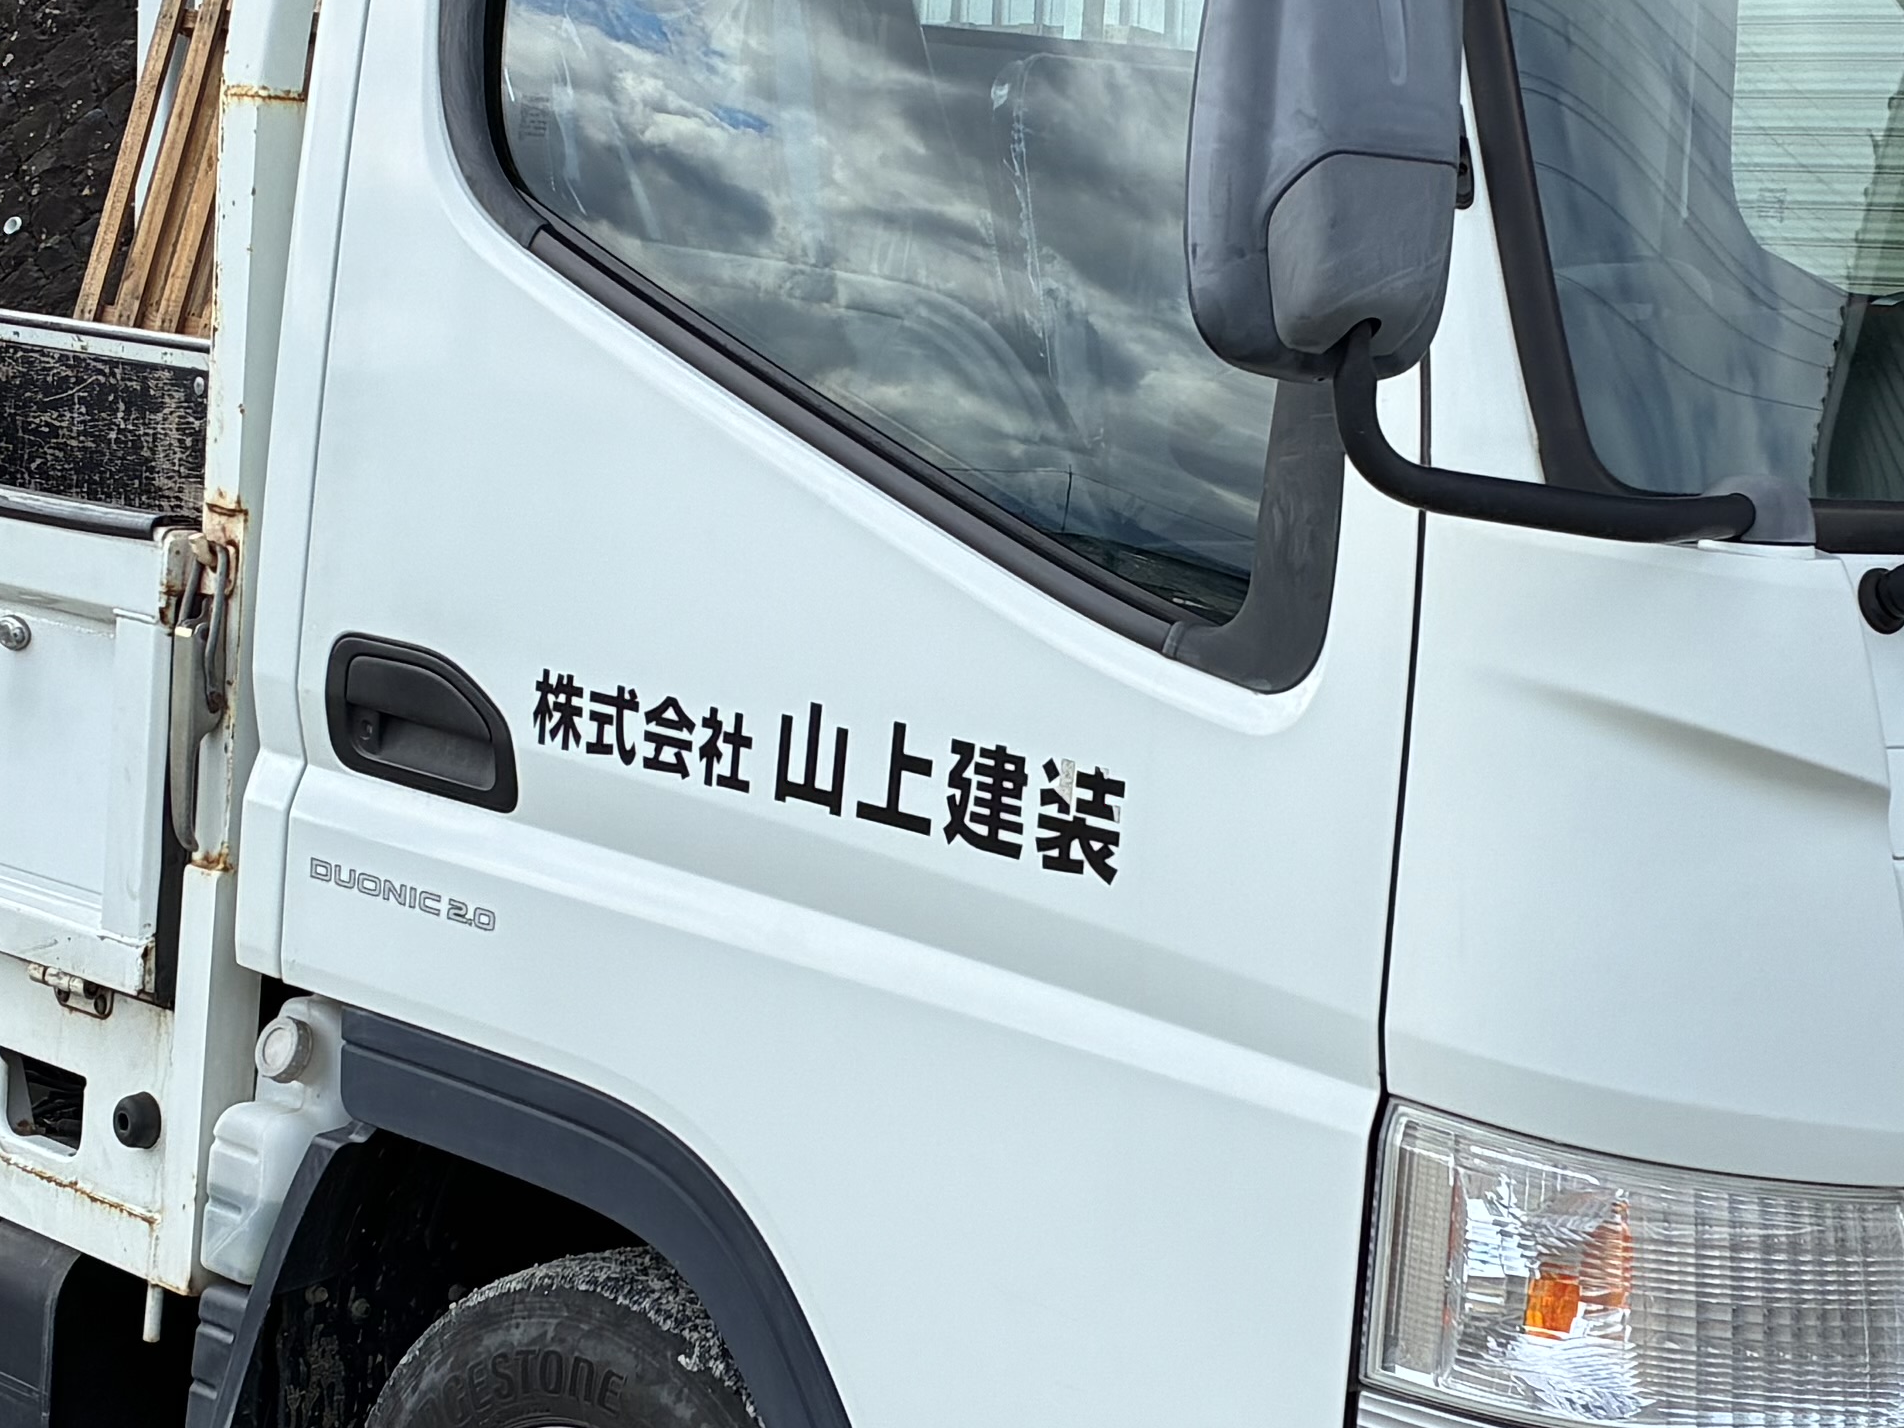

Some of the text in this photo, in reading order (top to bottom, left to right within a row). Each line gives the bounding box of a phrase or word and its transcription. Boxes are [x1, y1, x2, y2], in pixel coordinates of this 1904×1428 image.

[533, 668, 1126, 886] 株式会社 山上建装
[310, 857, 496, 932] DUONIC 2.0
